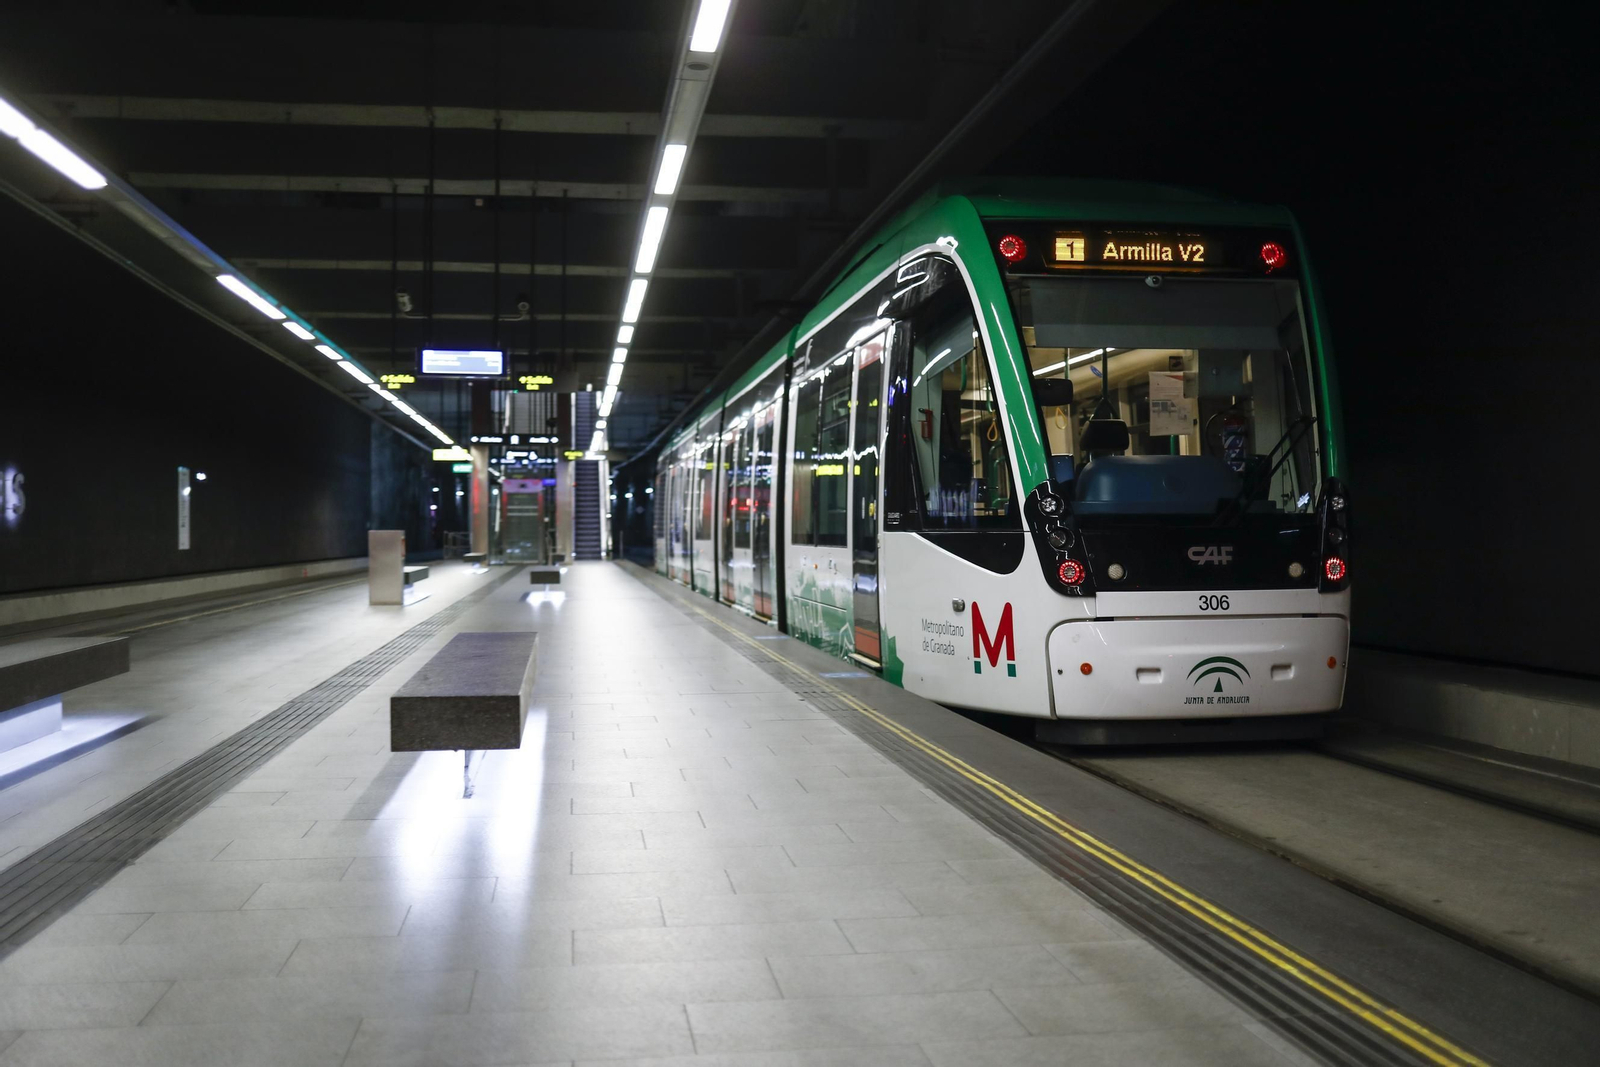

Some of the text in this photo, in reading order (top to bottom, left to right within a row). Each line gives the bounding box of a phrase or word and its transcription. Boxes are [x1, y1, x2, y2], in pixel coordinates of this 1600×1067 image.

[1103, 242, 1173, 261] Armilla
[1178, 244, 1205, 262] V2
[1187, 546, 1233, 565] CAF
[1199, 594, 1230, 611] 306
[921, 618, 965, 638] Metropolitano
[922, 637, 955, 656] de Granada
[971, 601, 1017, 677] M
[1184, 696, 1204, 705] JUNTA
[1206, 696, 1215, 705] DE
